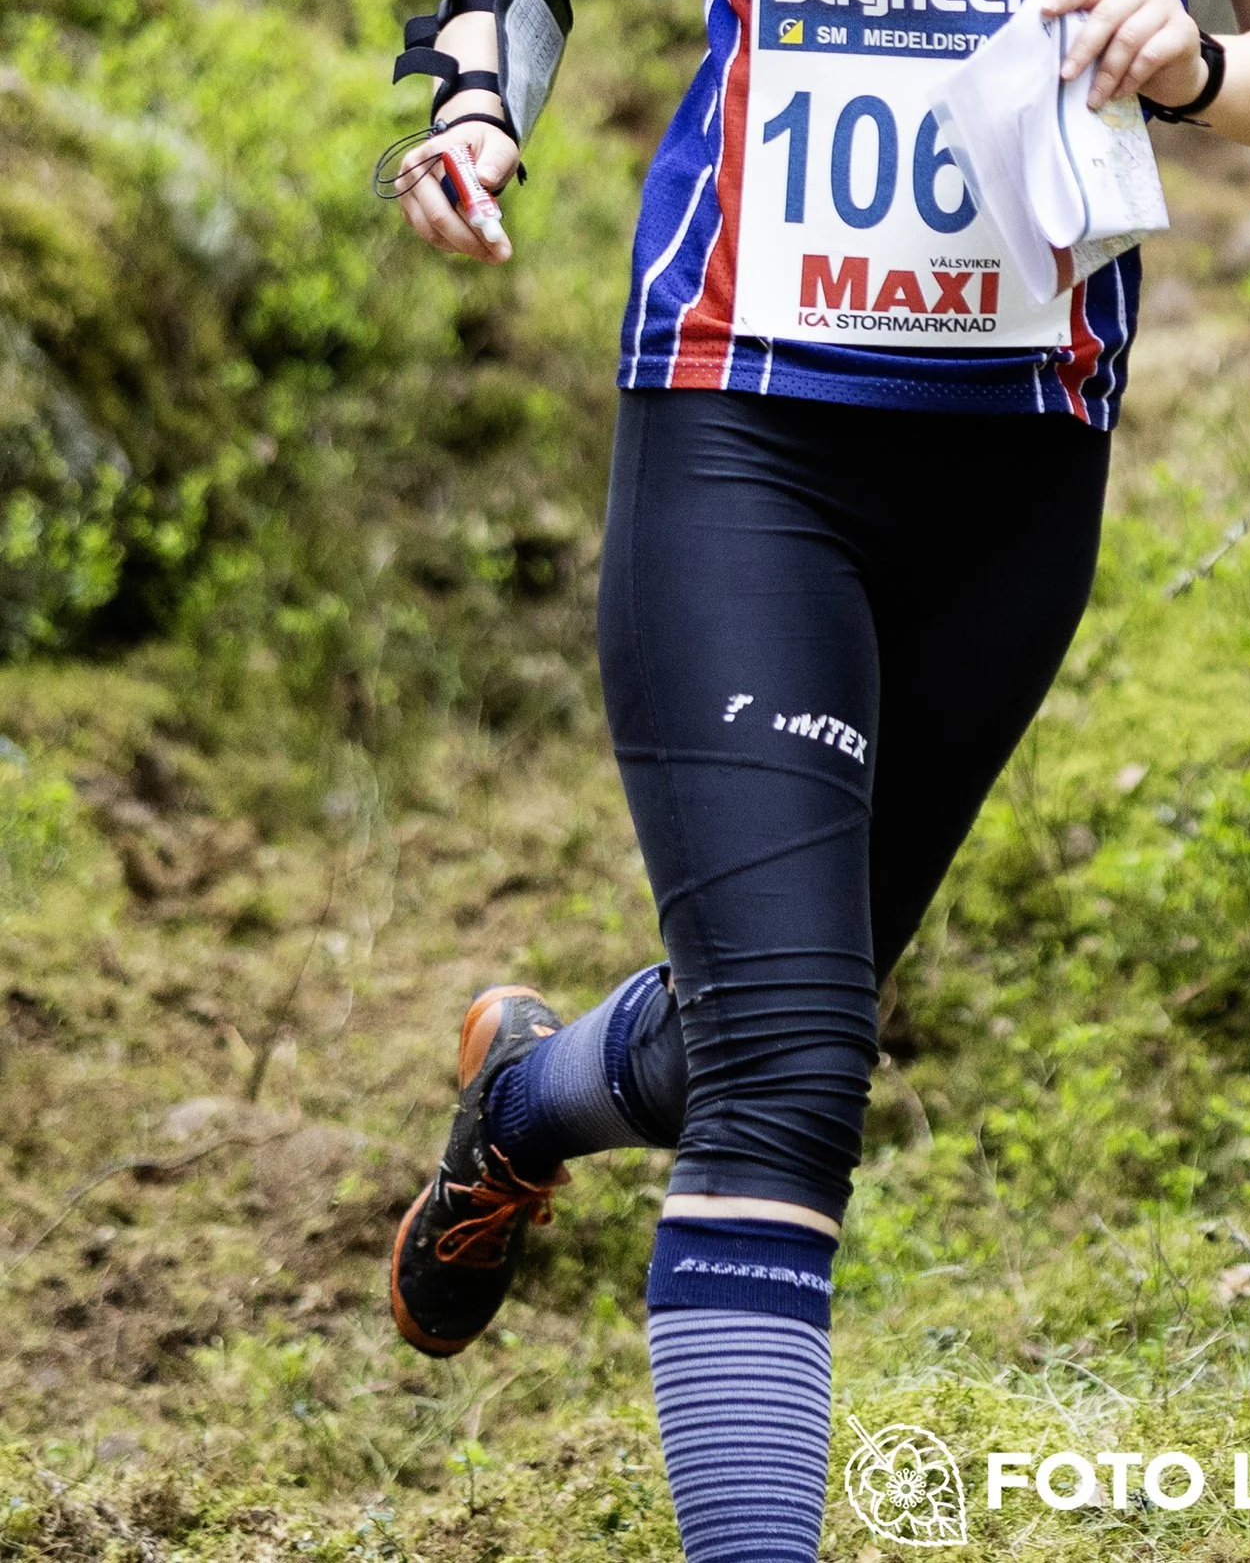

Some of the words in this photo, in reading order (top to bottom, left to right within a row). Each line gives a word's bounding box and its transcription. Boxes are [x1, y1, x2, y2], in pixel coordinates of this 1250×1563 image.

[816, 26, 848, 45] SM
[863, 28, 992, 52] MEDELDISTA
[929, 256, 1000, 269] VÄLSVIKEN
[800, 254, 1000, 315] MAXI
[798, 312, 831, 328] ICA
[836, 314, 997, 333] STORMARKNAD
